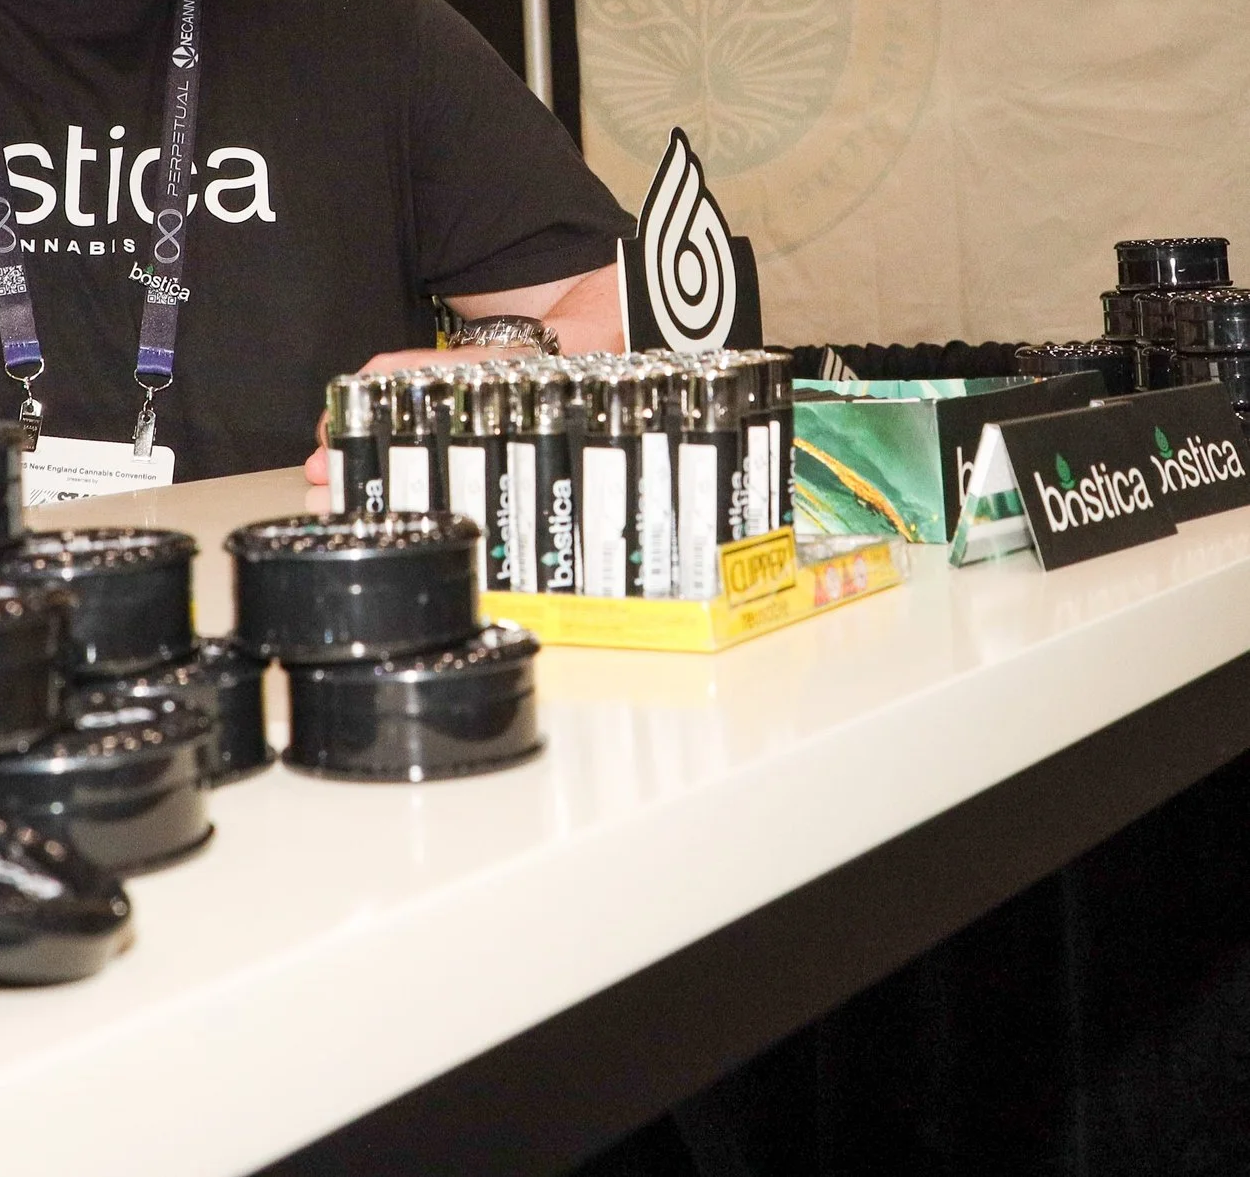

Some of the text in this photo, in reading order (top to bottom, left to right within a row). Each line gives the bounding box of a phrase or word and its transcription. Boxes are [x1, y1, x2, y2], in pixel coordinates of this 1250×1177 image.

[167, 80, 190, 197] PERPETUAL
[128, 261, 191, 303] bostica
[30, 463, 46, 471] New
[47, 464, 78, 474] England
[79, 467, 113, 477] Cannabis
[115, 470, 157, 481] Convention
[1034, 462, 1153, 532] bostica
[547, 478, 573, 588] bostica
